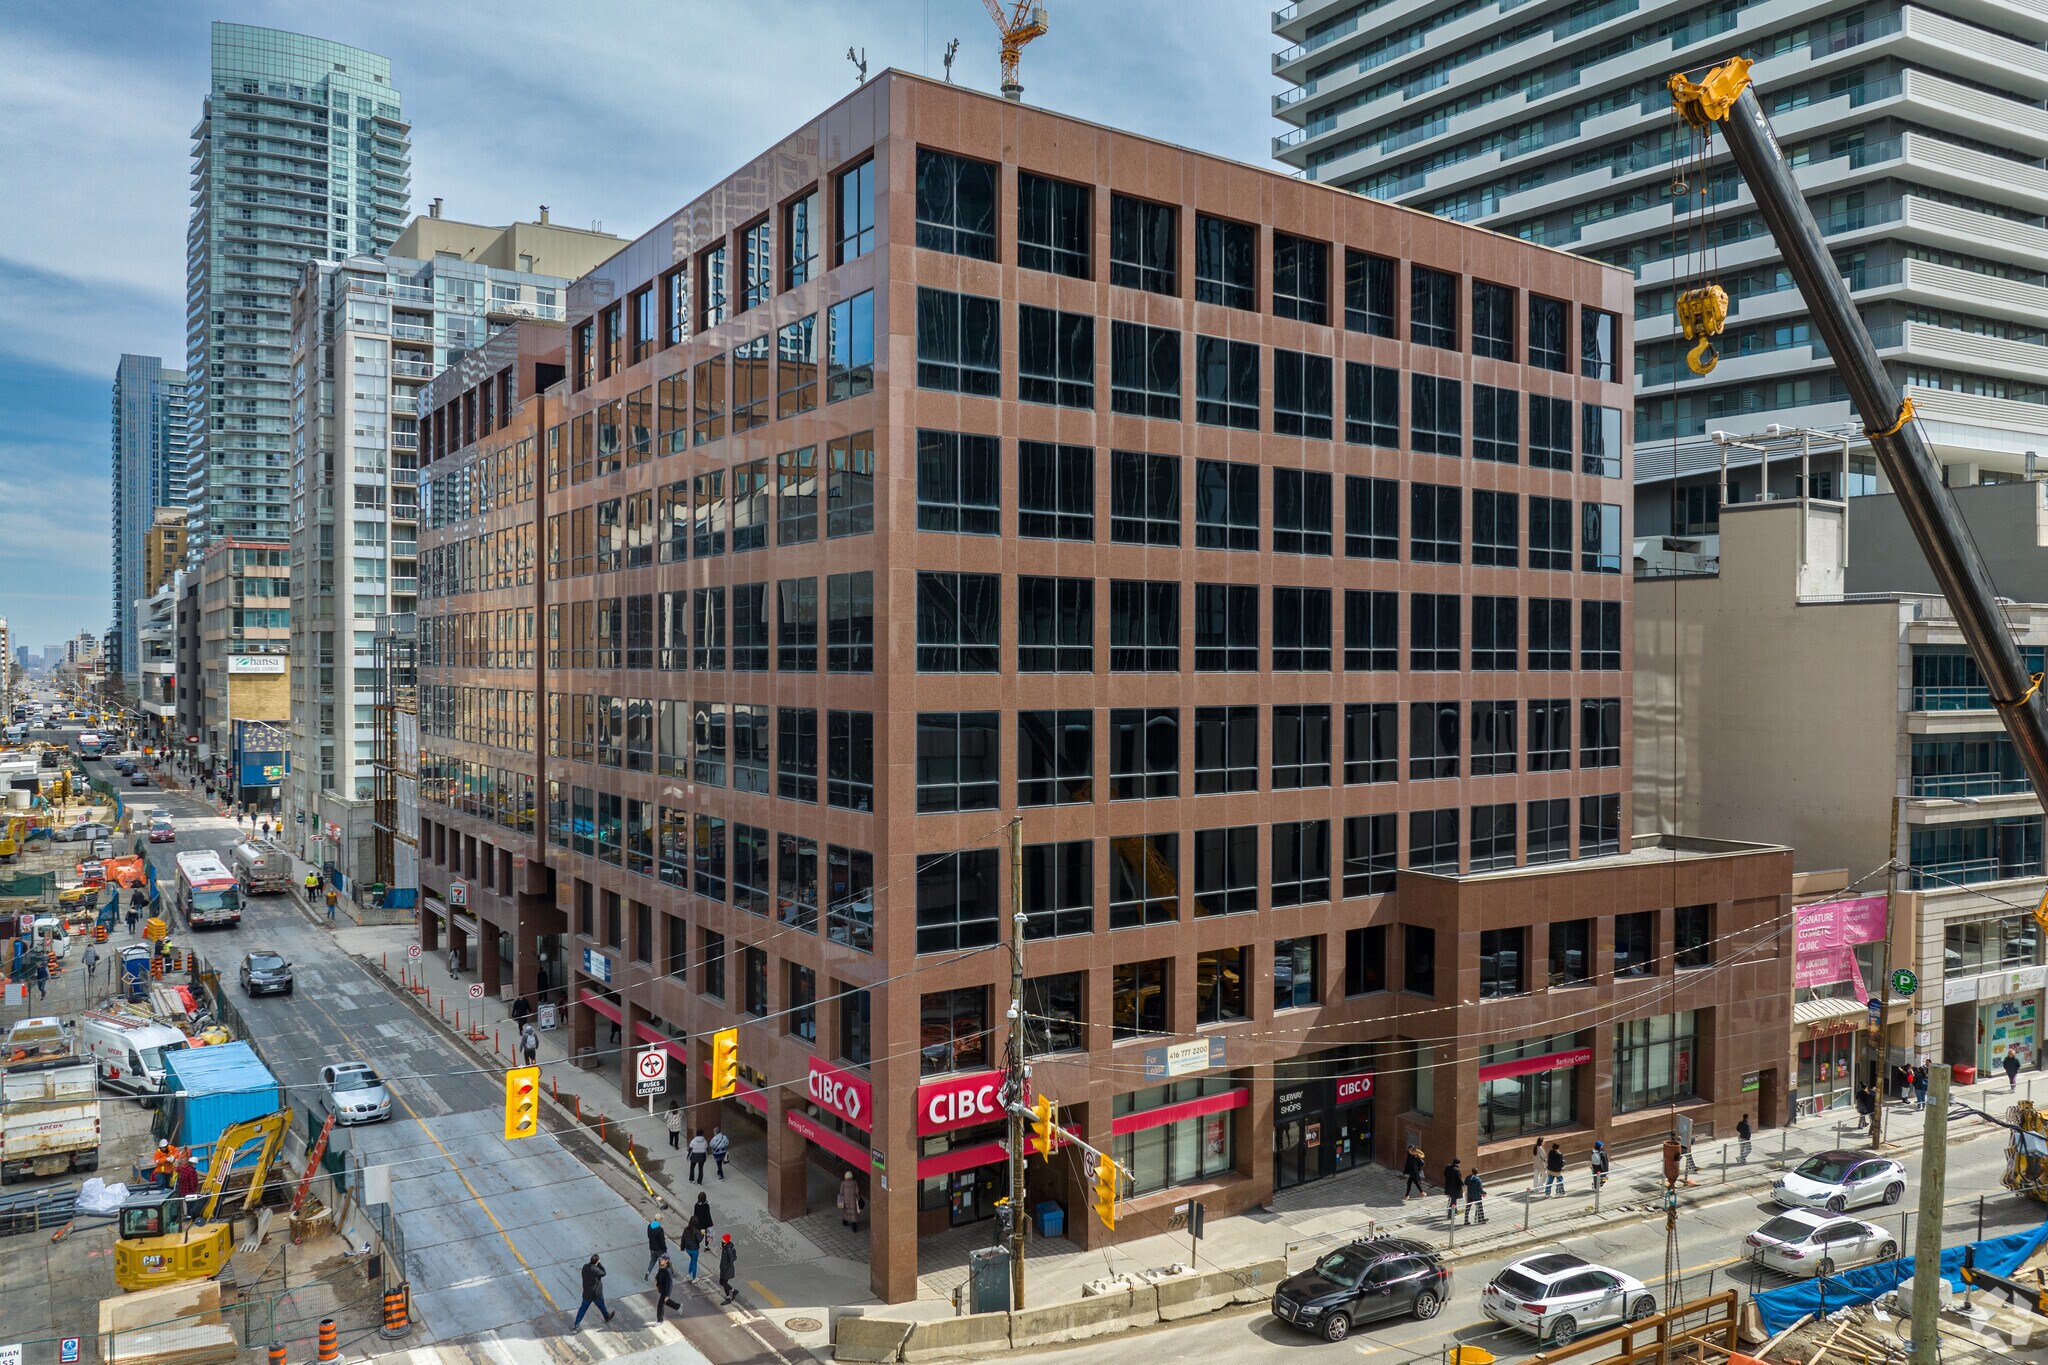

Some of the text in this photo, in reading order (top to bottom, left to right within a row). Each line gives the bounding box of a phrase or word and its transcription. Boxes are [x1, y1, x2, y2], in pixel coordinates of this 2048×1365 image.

[250, 657, 279, 666] hansa
[1798, 912, 1834, 926] SIGNATURE
[1181, 1048, 1192, 1057] 777
[1193, 1045, 1208, 1055] 2200
[1146, 1056, 1158, 1065] For
[1556, 1054, 1590, 1065] Banking Centre
[638, 1086, 665, 1095] EXCEPTED
[642, 1080, 660, 1089] BUSES
[808, 1069, 843, 1111] CIBC
[1339, 1080, 1361, 1097] CIBC
[1279, 1090, 1304, 1103] SUBWAY
[929, 1085, 994, 1124] CIBC
[1280, 1103, 1302, 1115] SHOPS
[143, 1255, 161, 1266] CAT
